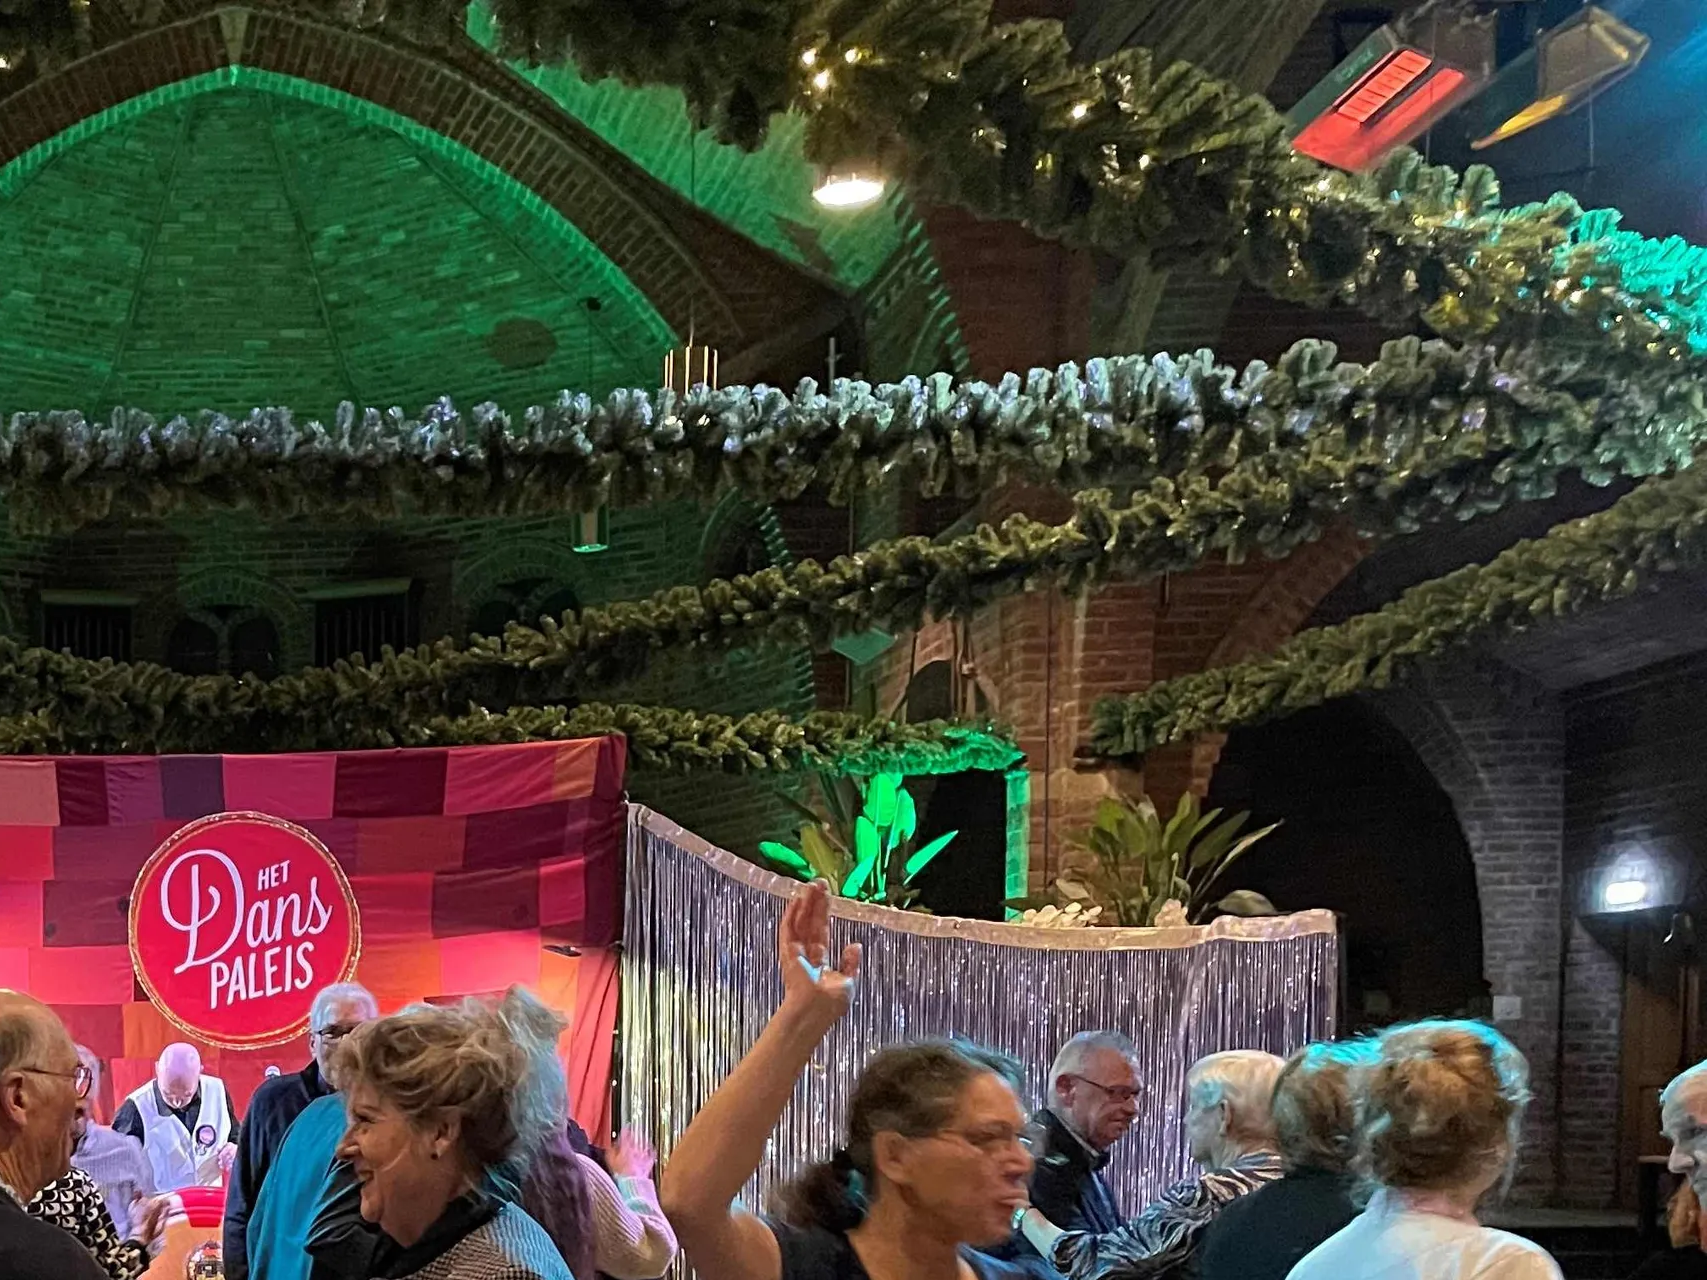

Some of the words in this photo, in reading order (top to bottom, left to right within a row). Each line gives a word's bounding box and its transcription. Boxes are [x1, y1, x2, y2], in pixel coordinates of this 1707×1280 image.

[258, 860, 290, 891] HET
[161, 849, 332, 974] Dans
[210, 941, 315, 1009] PALEIS
